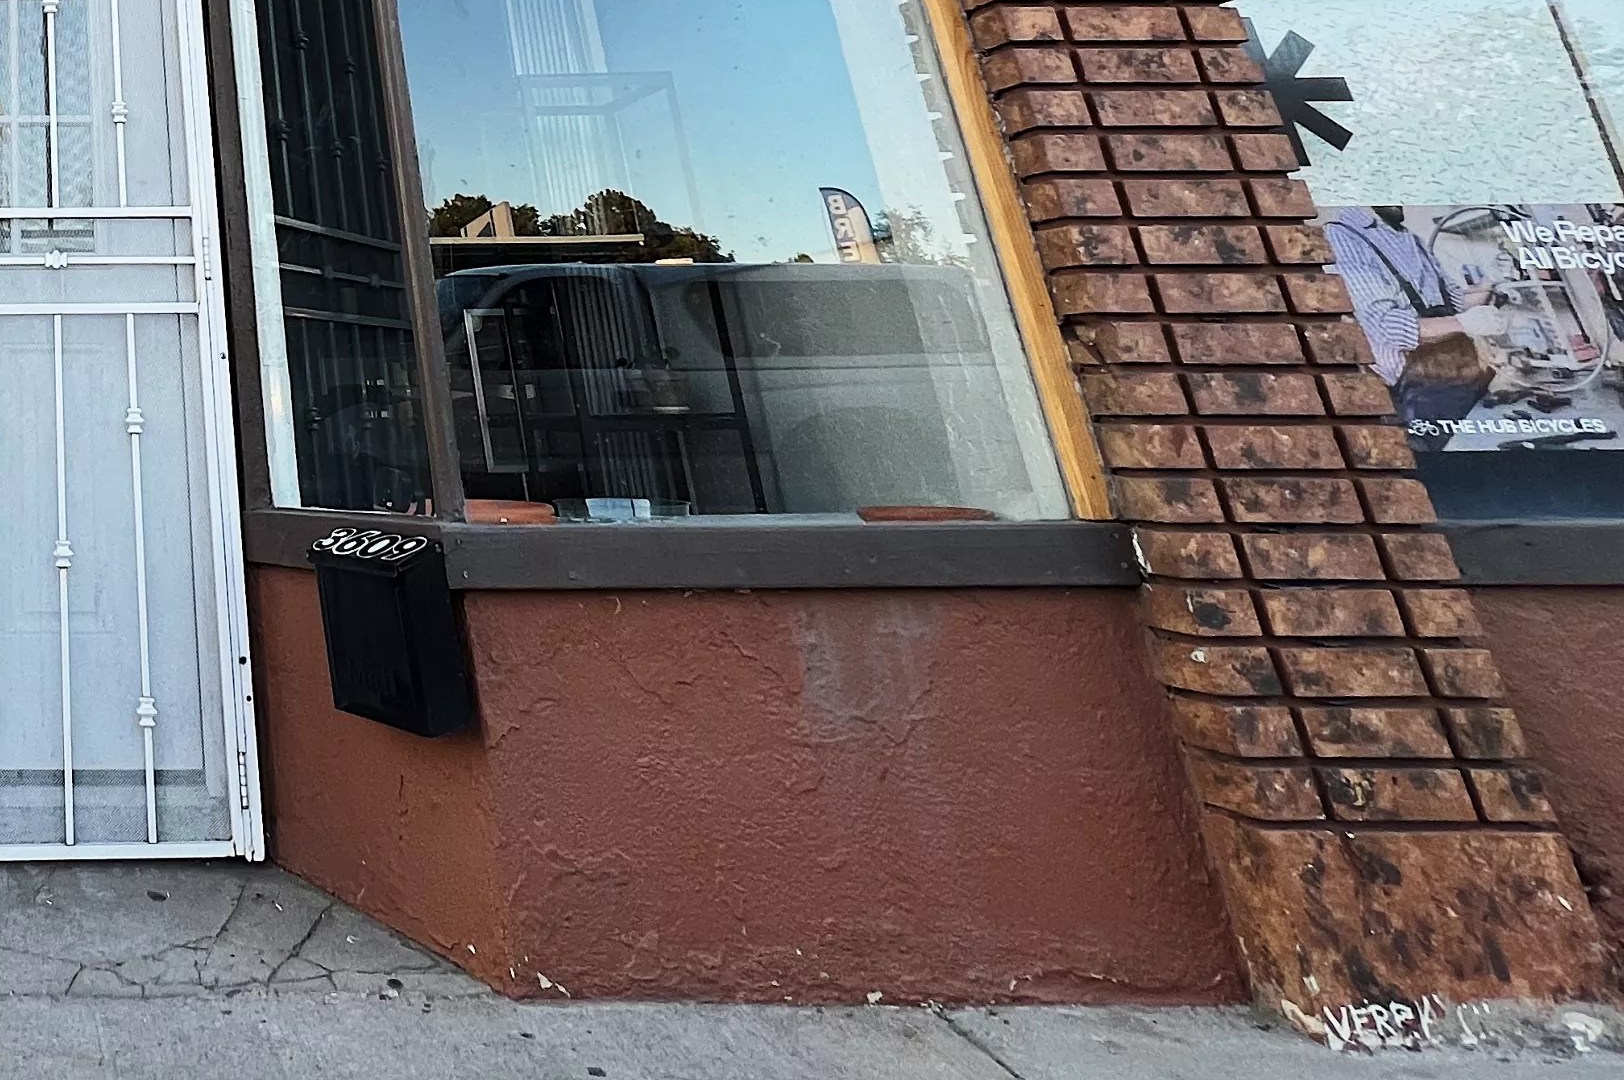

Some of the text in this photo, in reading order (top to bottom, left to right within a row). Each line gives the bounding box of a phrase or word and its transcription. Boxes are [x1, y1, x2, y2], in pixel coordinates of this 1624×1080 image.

[1500, 220, 1554, 242] We
[1518, 246, 1554, 270] All
[1439, 418, 1608, 434] THE HUB BICYCLES
[312, 527, 428, 561] 3609
